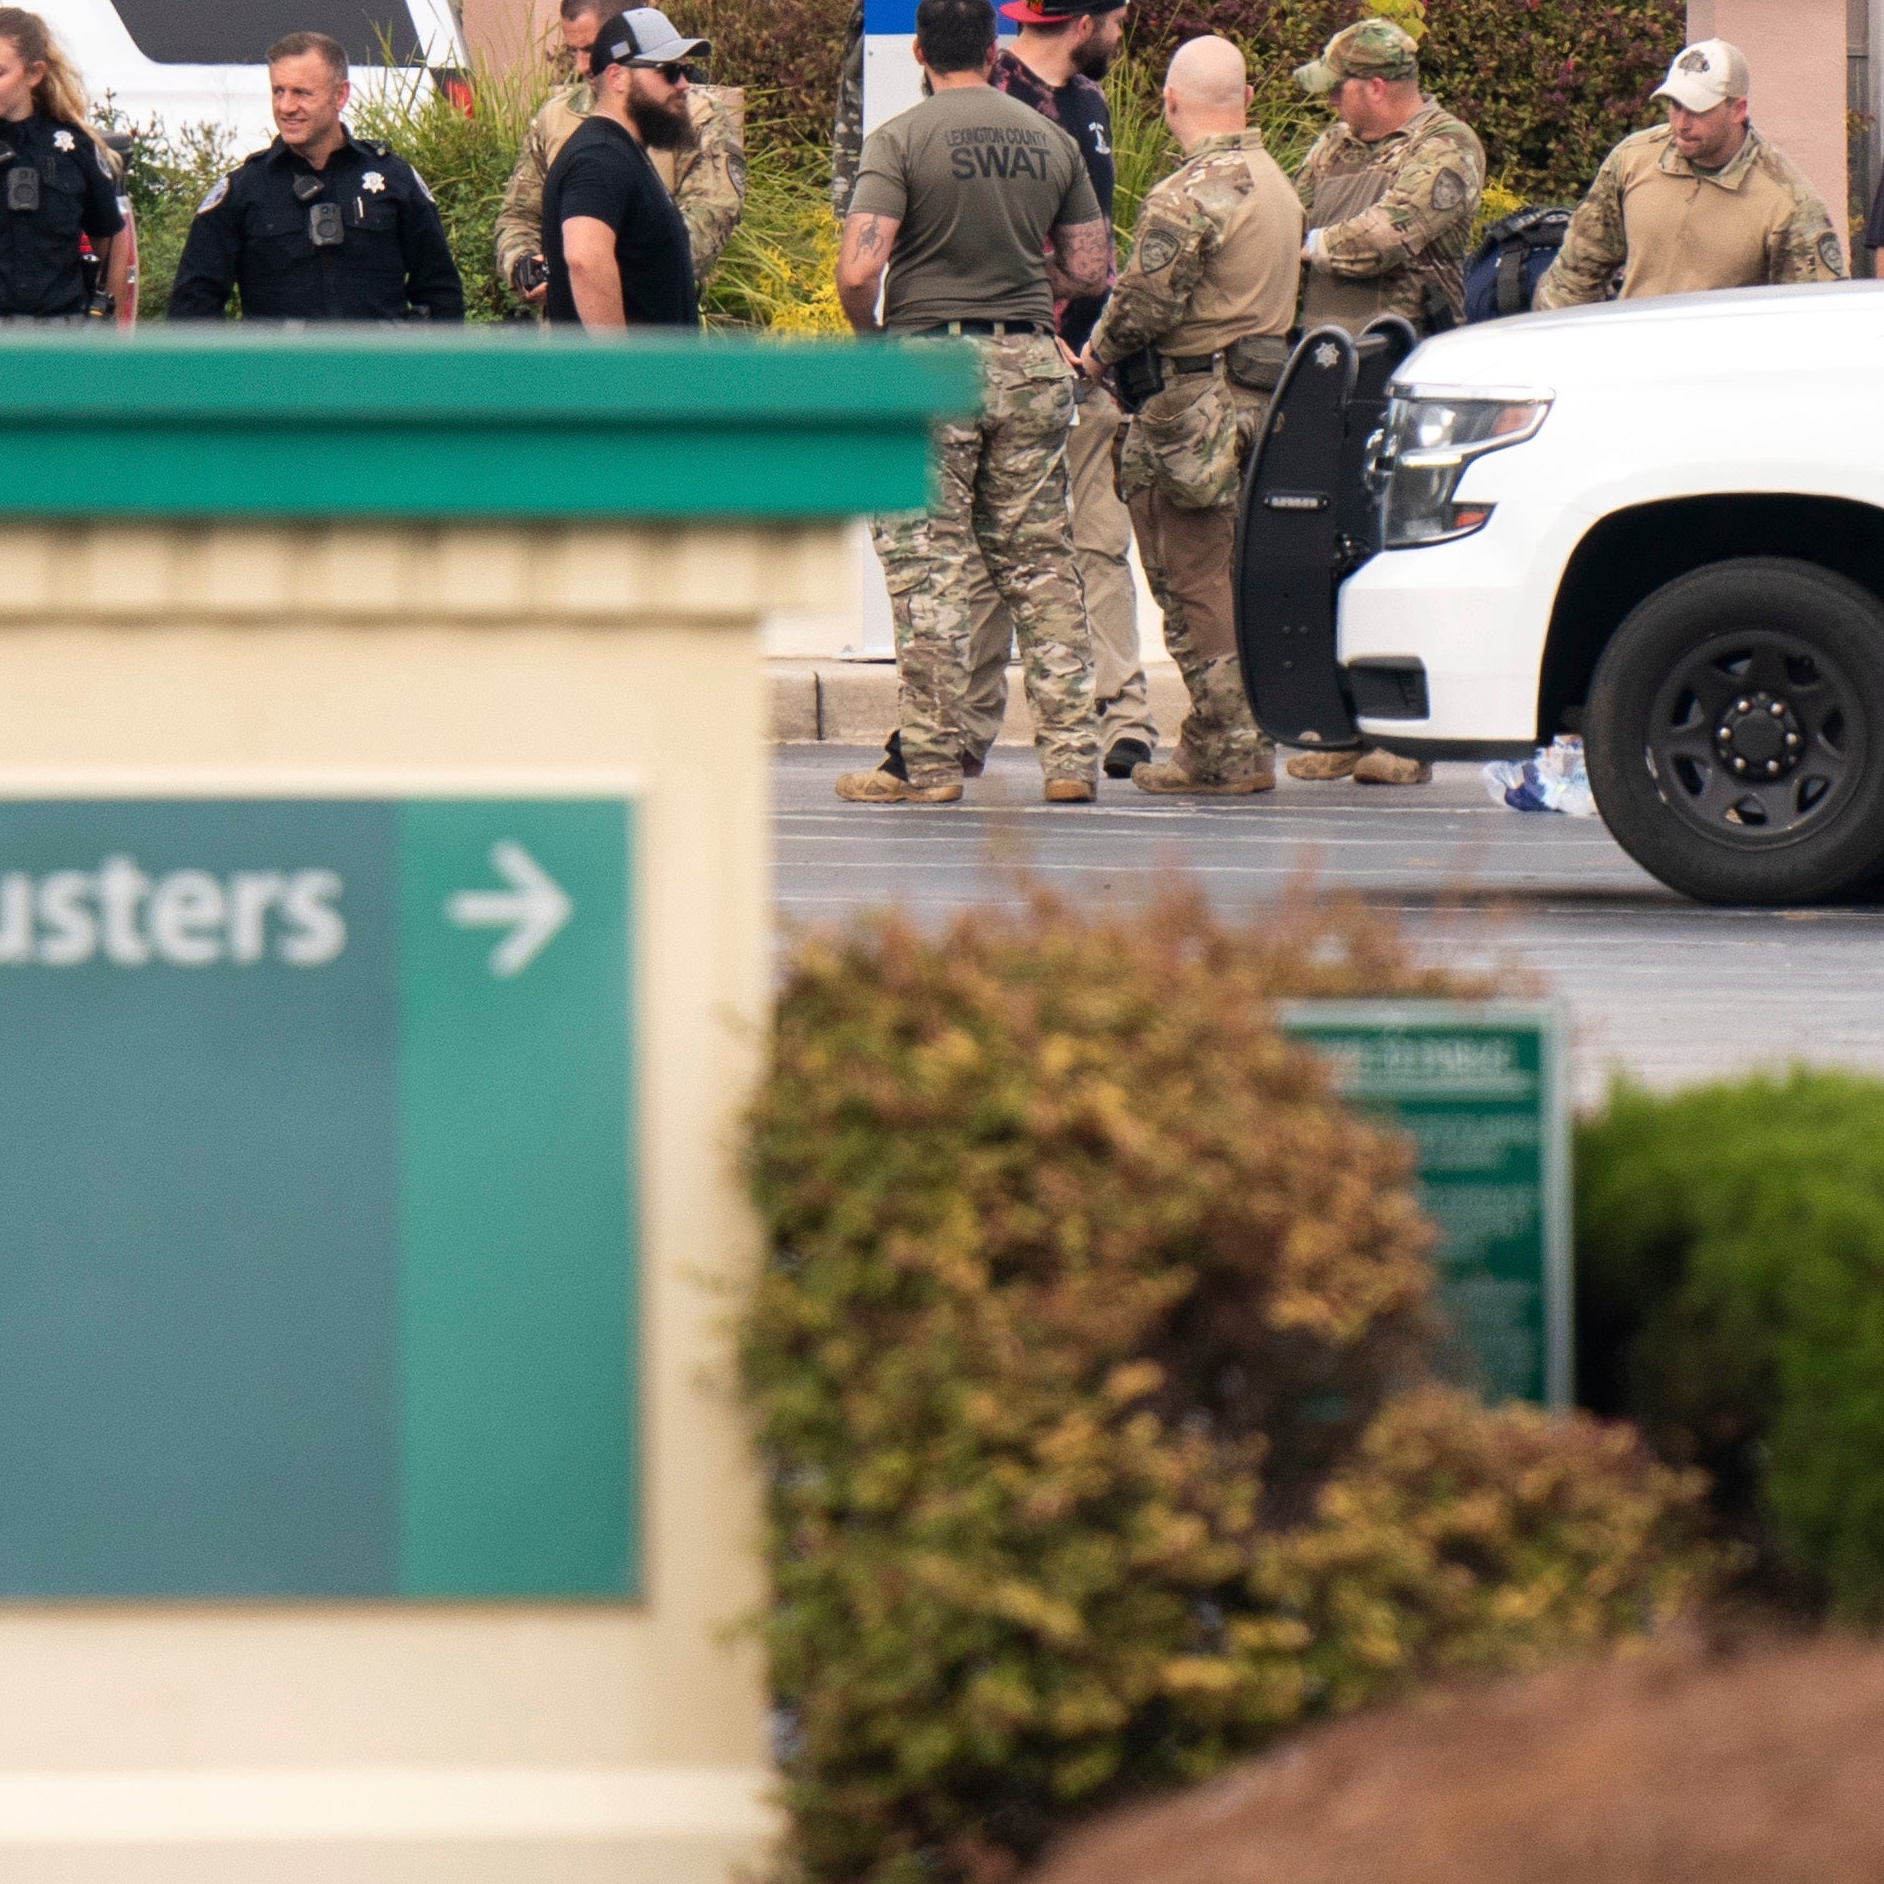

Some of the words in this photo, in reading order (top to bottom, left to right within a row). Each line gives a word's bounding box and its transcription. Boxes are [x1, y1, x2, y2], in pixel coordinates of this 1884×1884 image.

[945, 127, 1005, 146] LEXINGTON
[1007, 127, 1047, 146] COUNTY
[951, 144, 1051, 181] SWAT
